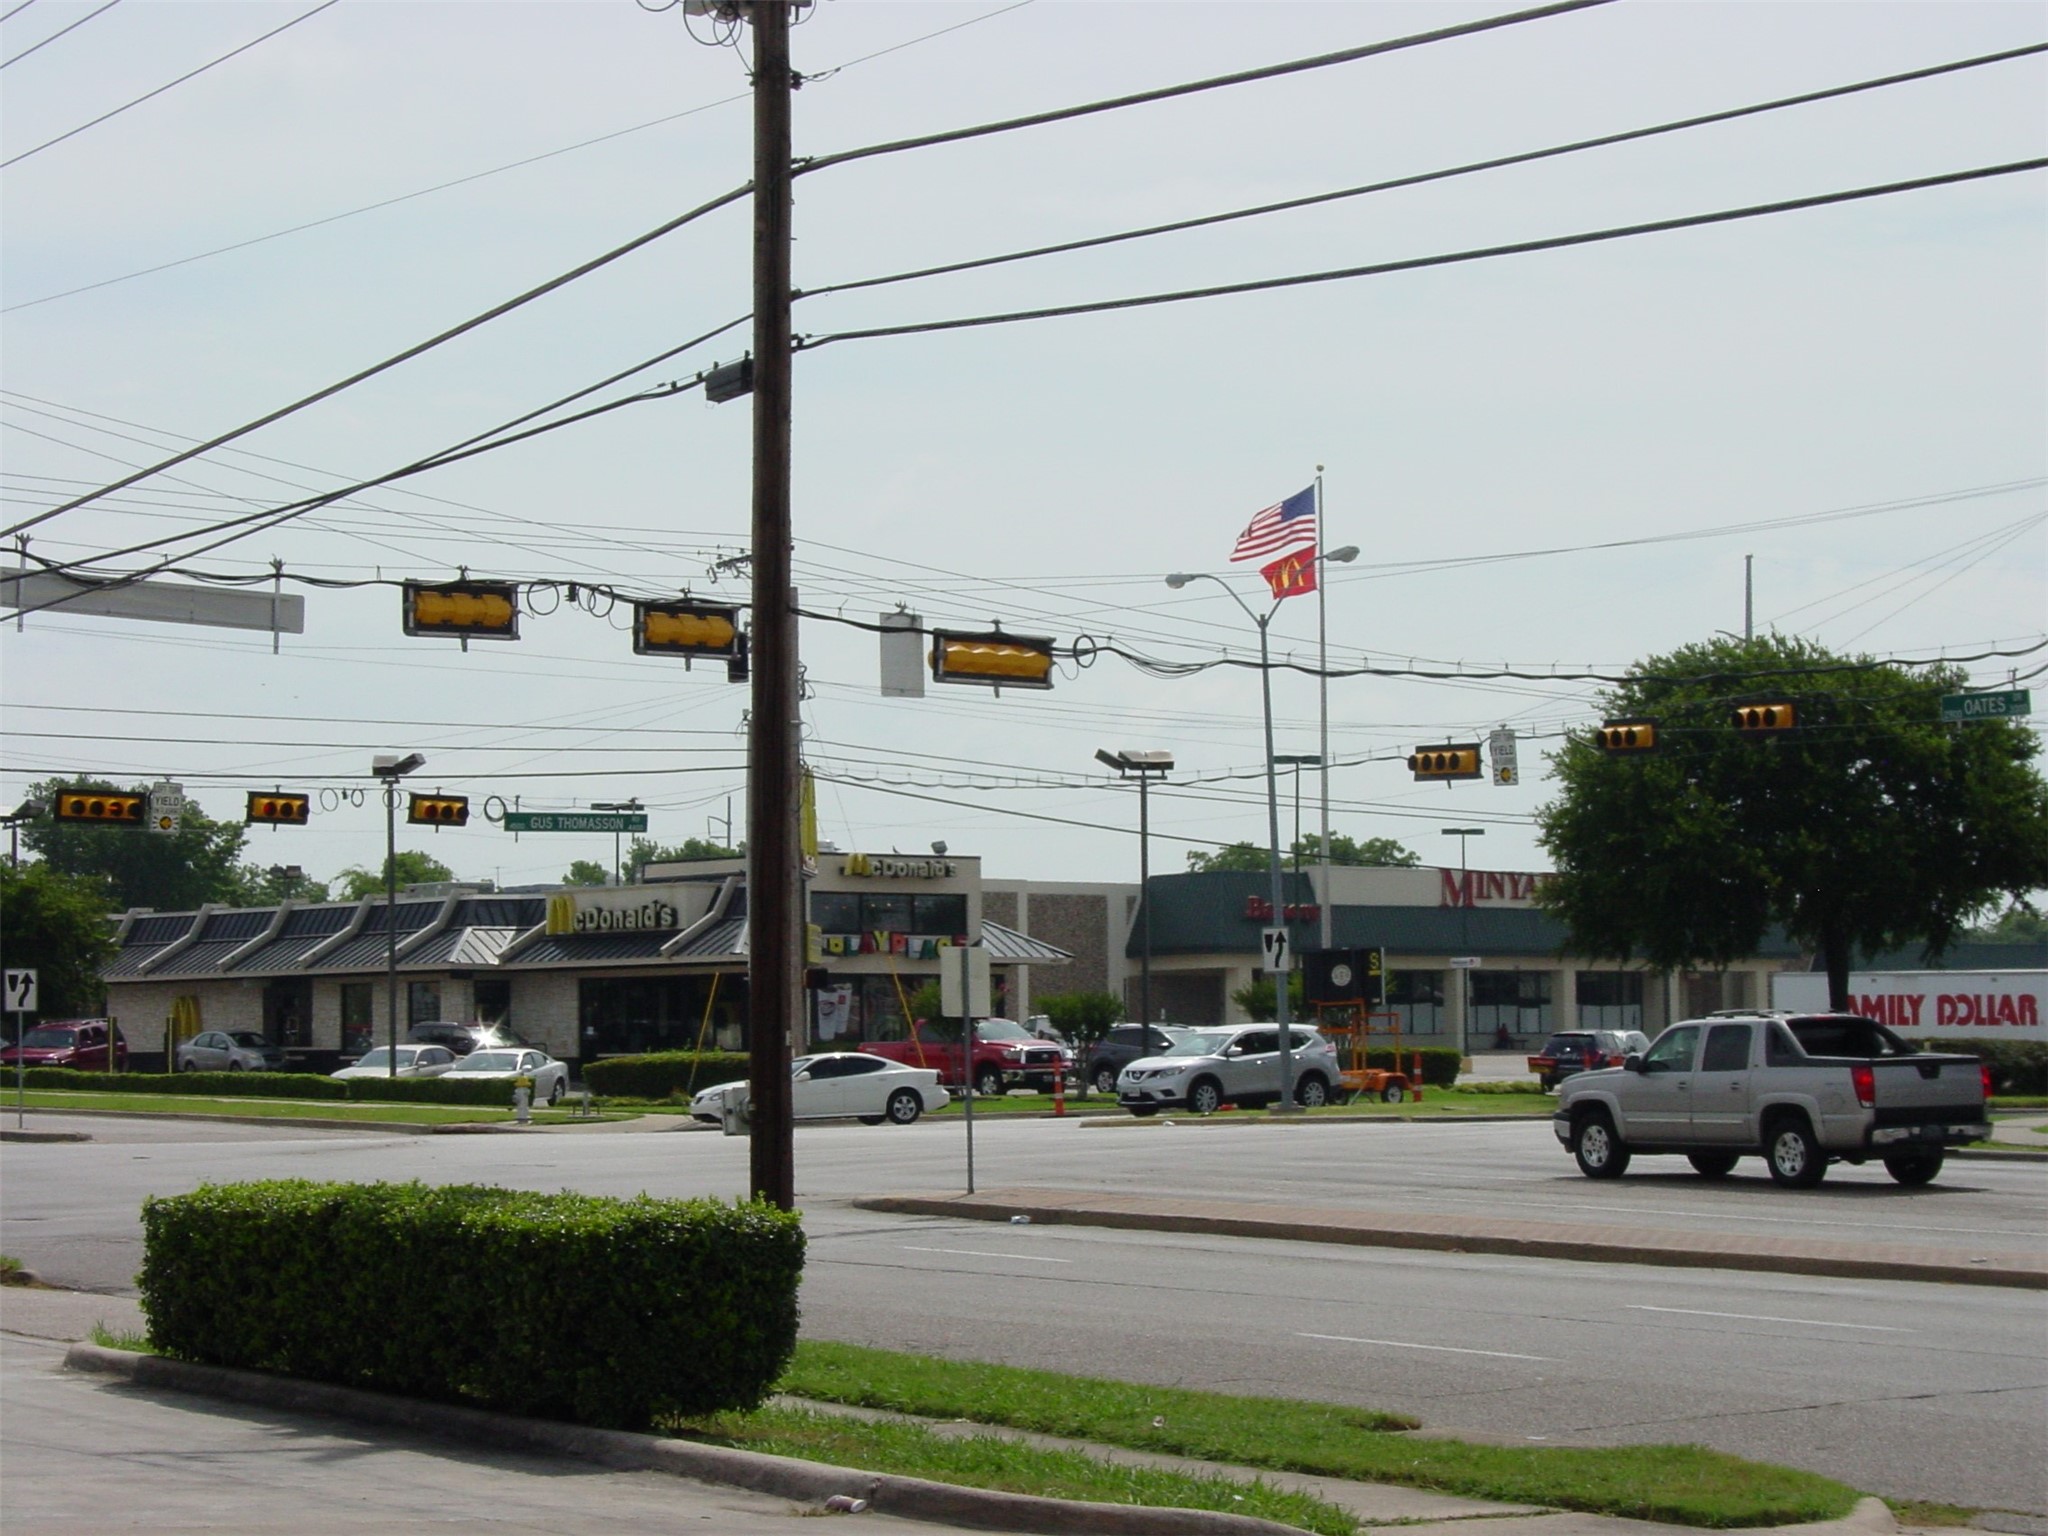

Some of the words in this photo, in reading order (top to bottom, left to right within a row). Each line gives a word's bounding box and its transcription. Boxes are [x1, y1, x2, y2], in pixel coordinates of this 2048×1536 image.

[1964, 697, 2006, 714] OATES
[155, 796, 179, 806] YIELD
[530, 816, 553, 829] GUS
[557, 817, 624, 829] THOMASSON
[843, 853, 957, 877] McDonald's
[546, 895, 676, 935] McDonald's
[1847, 994, 1925, 1026] AMILY
[1937, 994, 2038, 1026] DOLLAR
